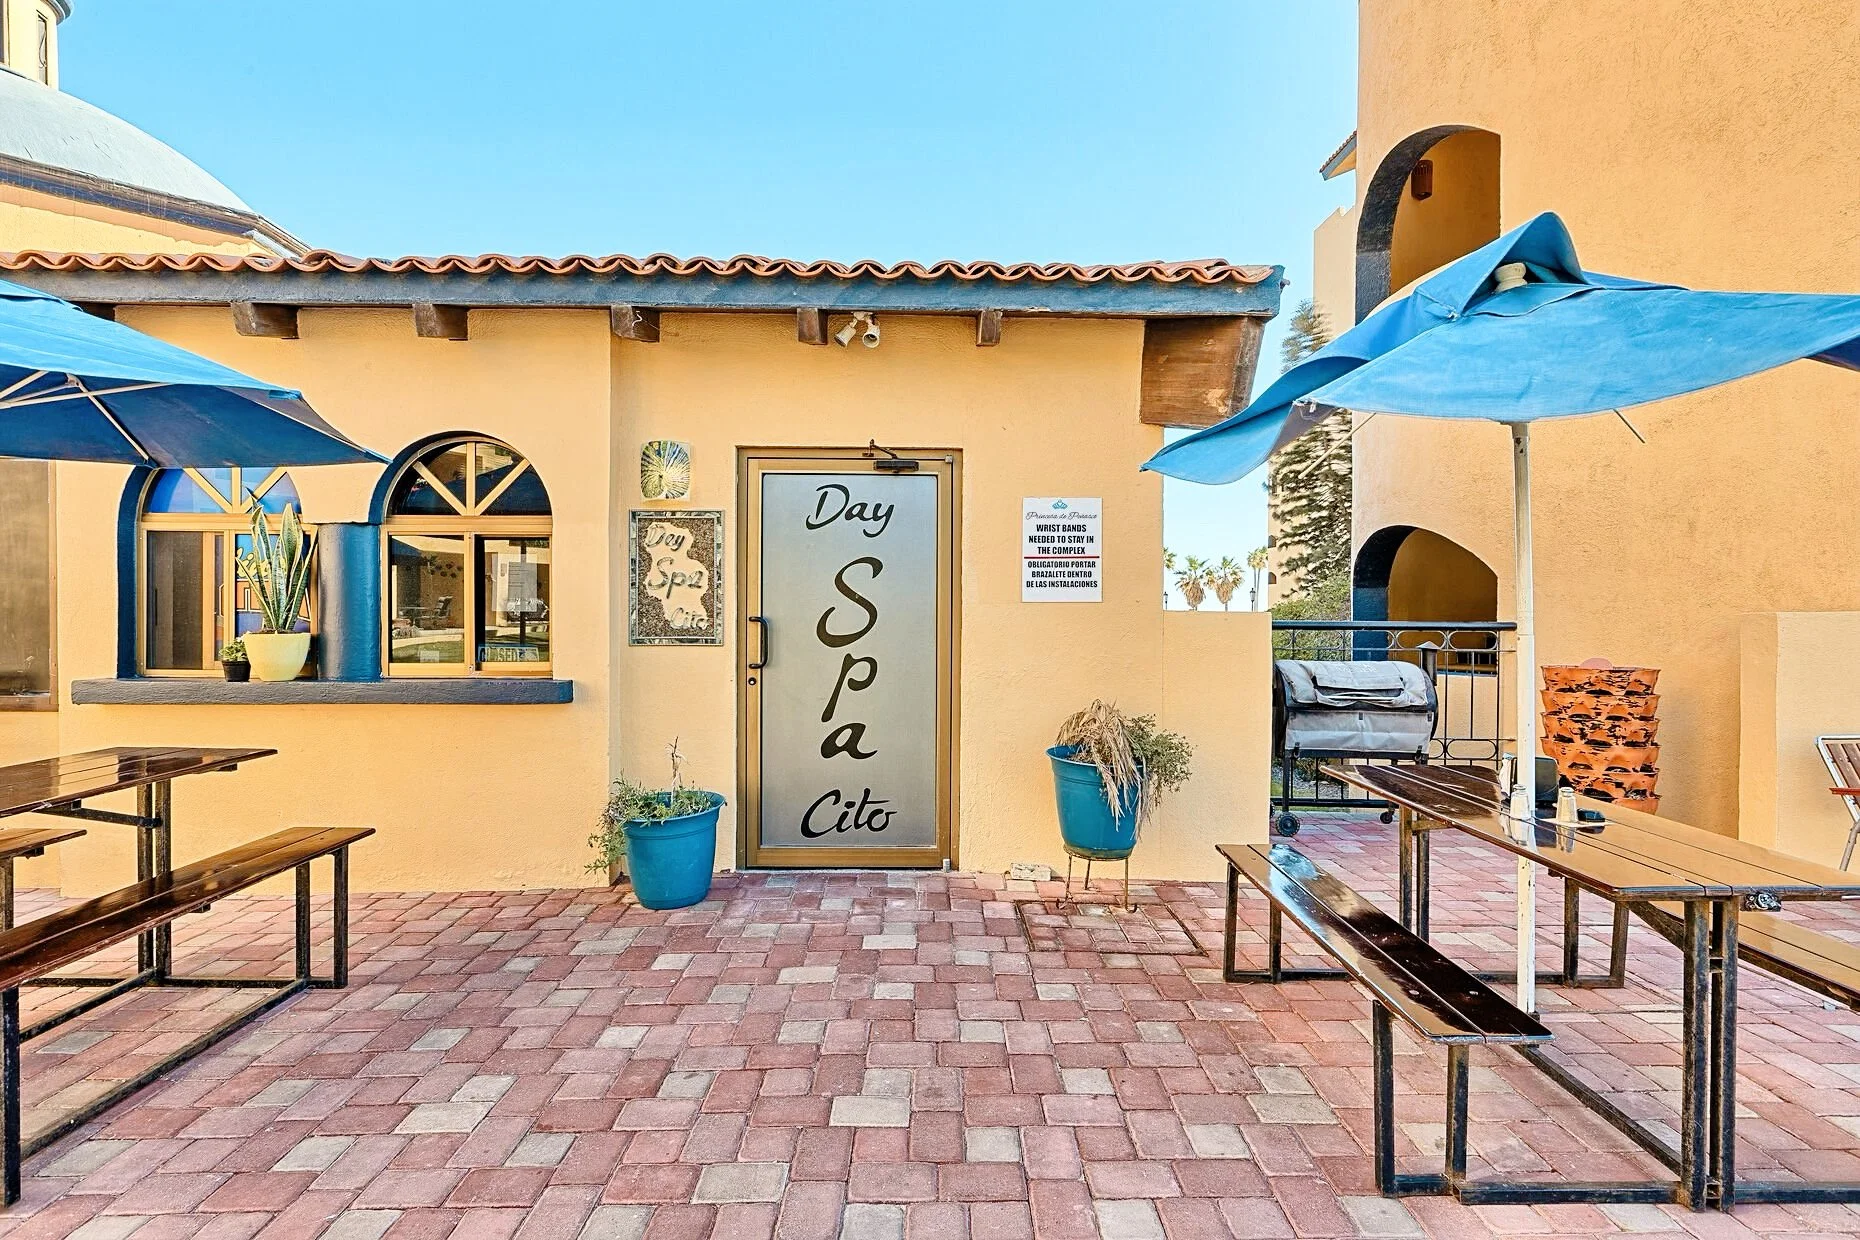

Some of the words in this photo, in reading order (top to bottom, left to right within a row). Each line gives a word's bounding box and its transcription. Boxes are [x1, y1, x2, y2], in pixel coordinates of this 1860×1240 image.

[806, 484, 895, 538] Day
[1036, 524, 1060, 533] WRIST
[1062, 524, 1087, 533] BANDS
[645, 523, 685, 552] Day
[1028, 535, 1055, 544] NEEDED
[1057, 535, 1066, 544] TO
[1067, 535, 1085, 544] STAY
[1086, 535, 1094, 544] IN
[1037, 546, 1051, 555] THE
[1052, 546, 1086, 555] COMPLEX
[1027, 560, 1070, 569] OBLIGATORIO
[1071, 560, 1096, 569] PORTAR
[647, 556, 704, 600] Spa
[1031, 570, 1066, 578] BRAZALETE
[1067, 570, 1092, 578] DENTRO
[1026, 580, 1035, 588] DE
[1035, 580, 1047, 588] LAS
[1048, 580, 1098, 588] INSTALACIONES
[670, 607, 711, 630] Cito
[800, 787, 898, 839] Cito
